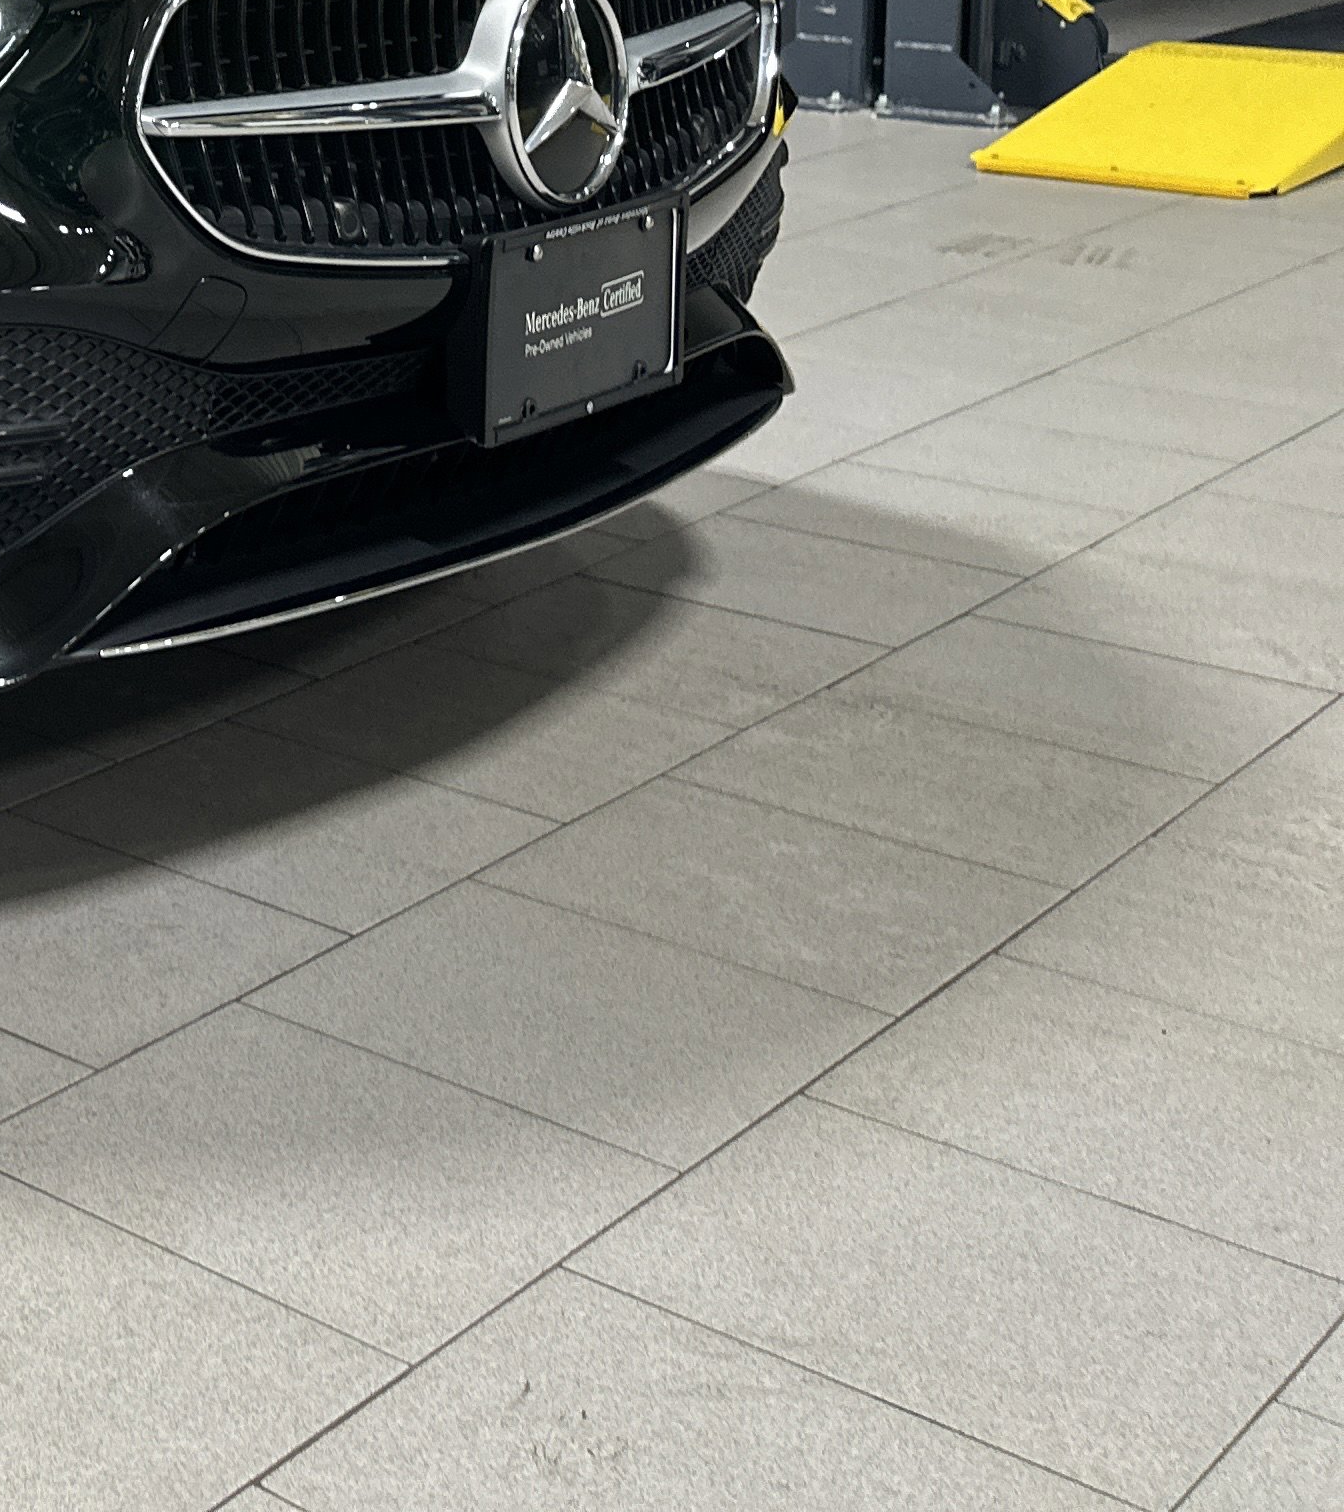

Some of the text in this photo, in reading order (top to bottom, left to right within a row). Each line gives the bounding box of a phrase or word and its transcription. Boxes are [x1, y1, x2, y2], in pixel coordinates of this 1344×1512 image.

[525, 278, 641, 336] Mercedes-Benz Certified
[525, 335, 564, 358] Pre-Owned
